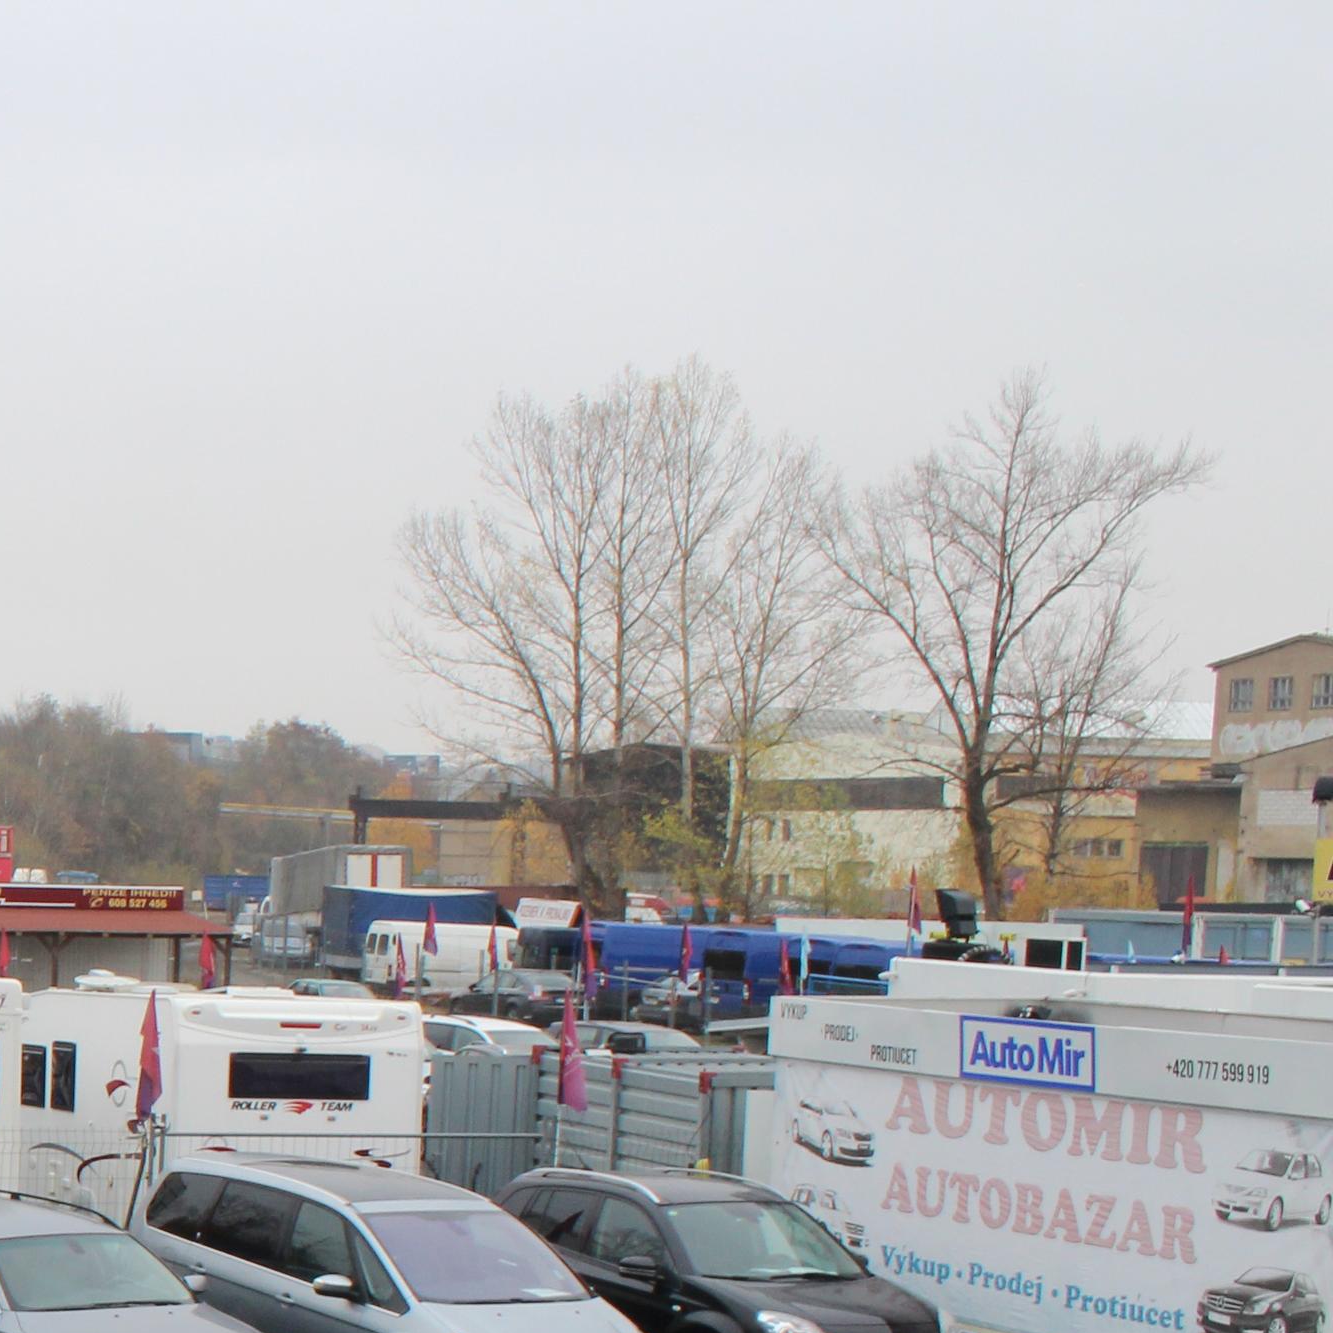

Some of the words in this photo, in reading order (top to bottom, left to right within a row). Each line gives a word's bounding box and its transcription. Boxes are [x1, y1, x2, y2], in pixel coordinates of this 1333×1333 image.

[780, 1003, 808, 1020] VYKUP
[823, 1023, 855, 1042] PRODEJ
[1165, 1059, 1194, 1079] +420
[1197, 1060, 1219, 1081] 777
[1221, 1062, 1244, 1083] 599
[1246, 1064, 1270, 1085] 919
[231, 1101, 277, 1112] ROLLER
[320, 1101, 353, 1112] TEAM
[885, 1075, 1207, 1174] AUTOMIR
[880, 1162, 1198, 1265] AUTOBAZAR
[967, 1262, 1043, 1305] Prodej
